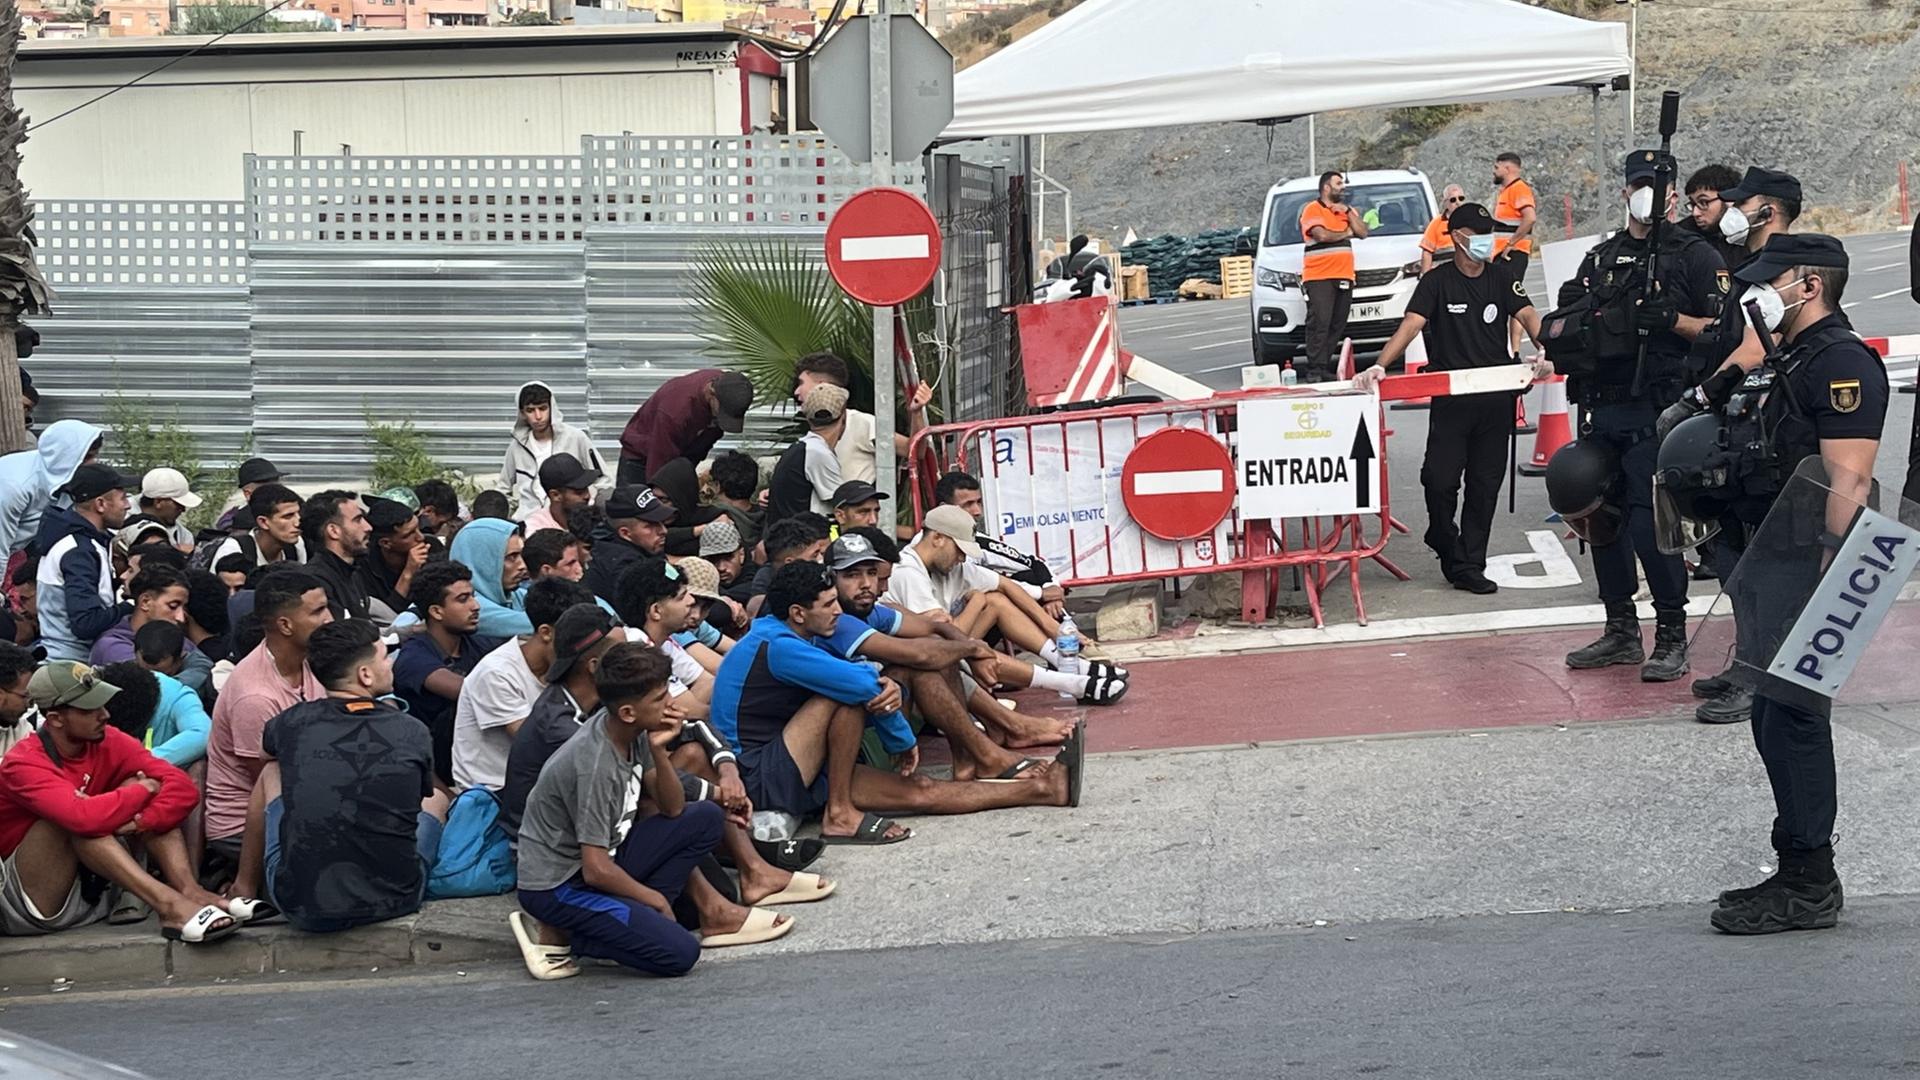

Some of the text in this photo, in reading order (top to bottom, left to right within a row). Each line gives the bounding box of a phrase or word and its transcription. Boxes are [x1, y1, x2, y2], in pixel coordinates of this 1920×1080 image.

[1360, 306, 1381, 317] MPK
[1291, 402, 1318, 411] GRUPO
[1284, 430, 1333, 440] SEGURIDAD
[1245, 456, 1348, 487] ENTRADA
[1794, 536, 1907, 681] POLICIA
